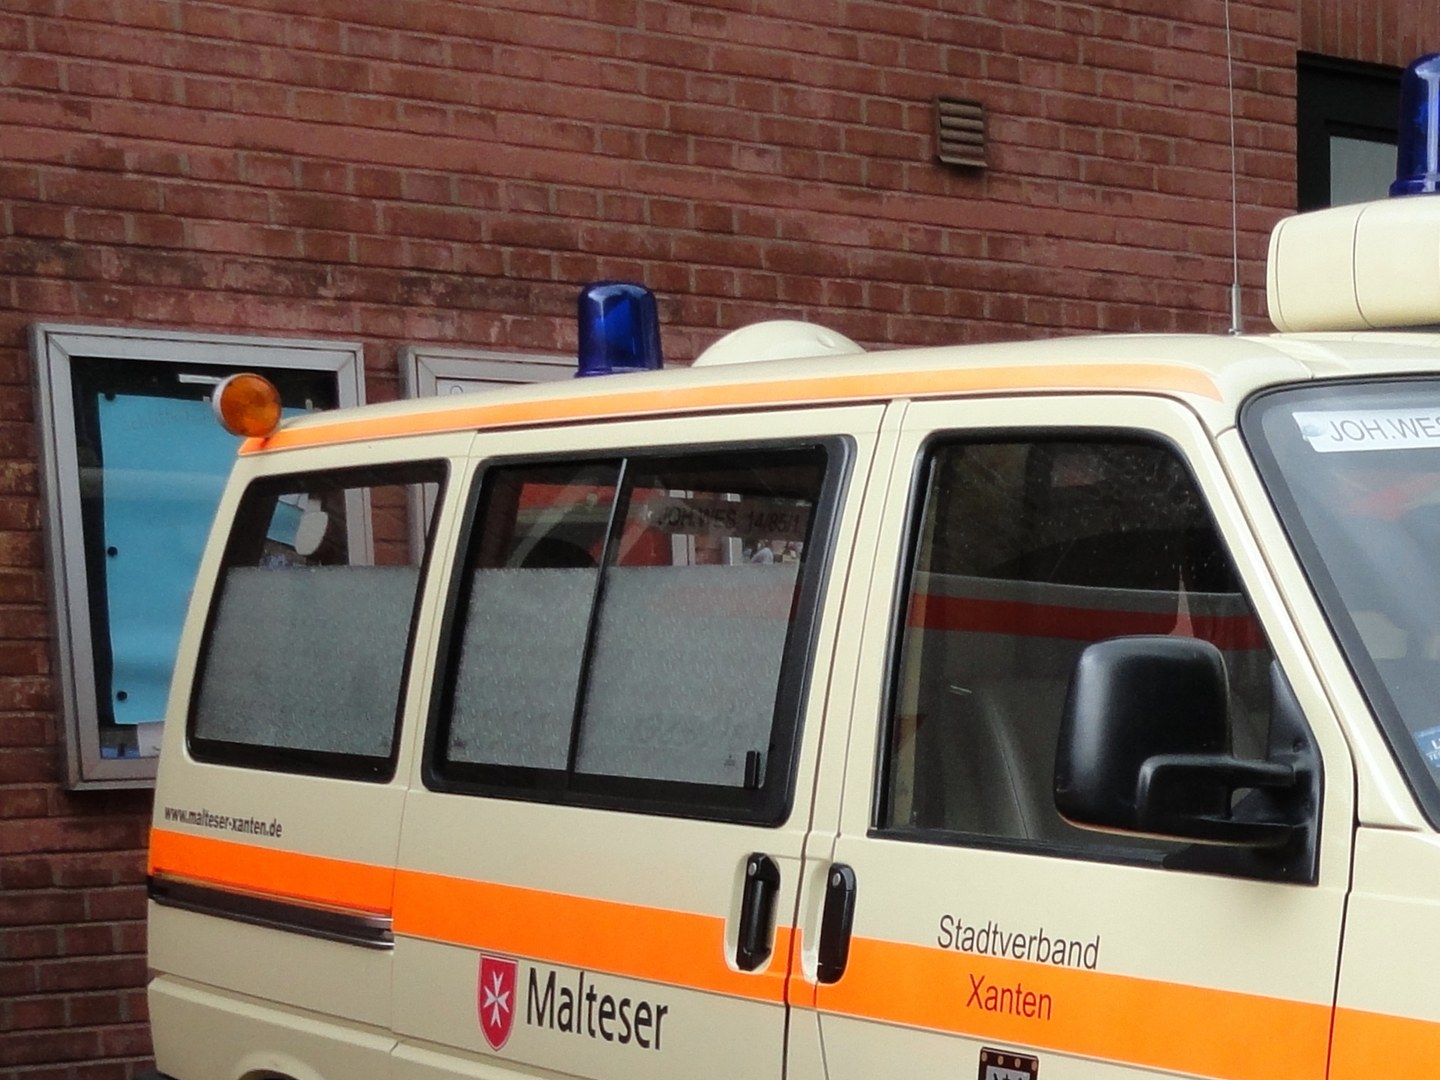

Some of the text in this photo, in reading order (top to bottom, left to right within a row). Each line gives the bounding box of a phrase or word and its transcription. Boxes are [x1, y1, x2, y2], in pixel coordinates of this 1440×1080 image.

[164, 807, 282, 837] www.malteser-xanten.de
[937, 914, 1100, 970] Stadtverband
[526, 967, 668, 1050] Malteser
[966, 973, 1052, 1021] Xanten
